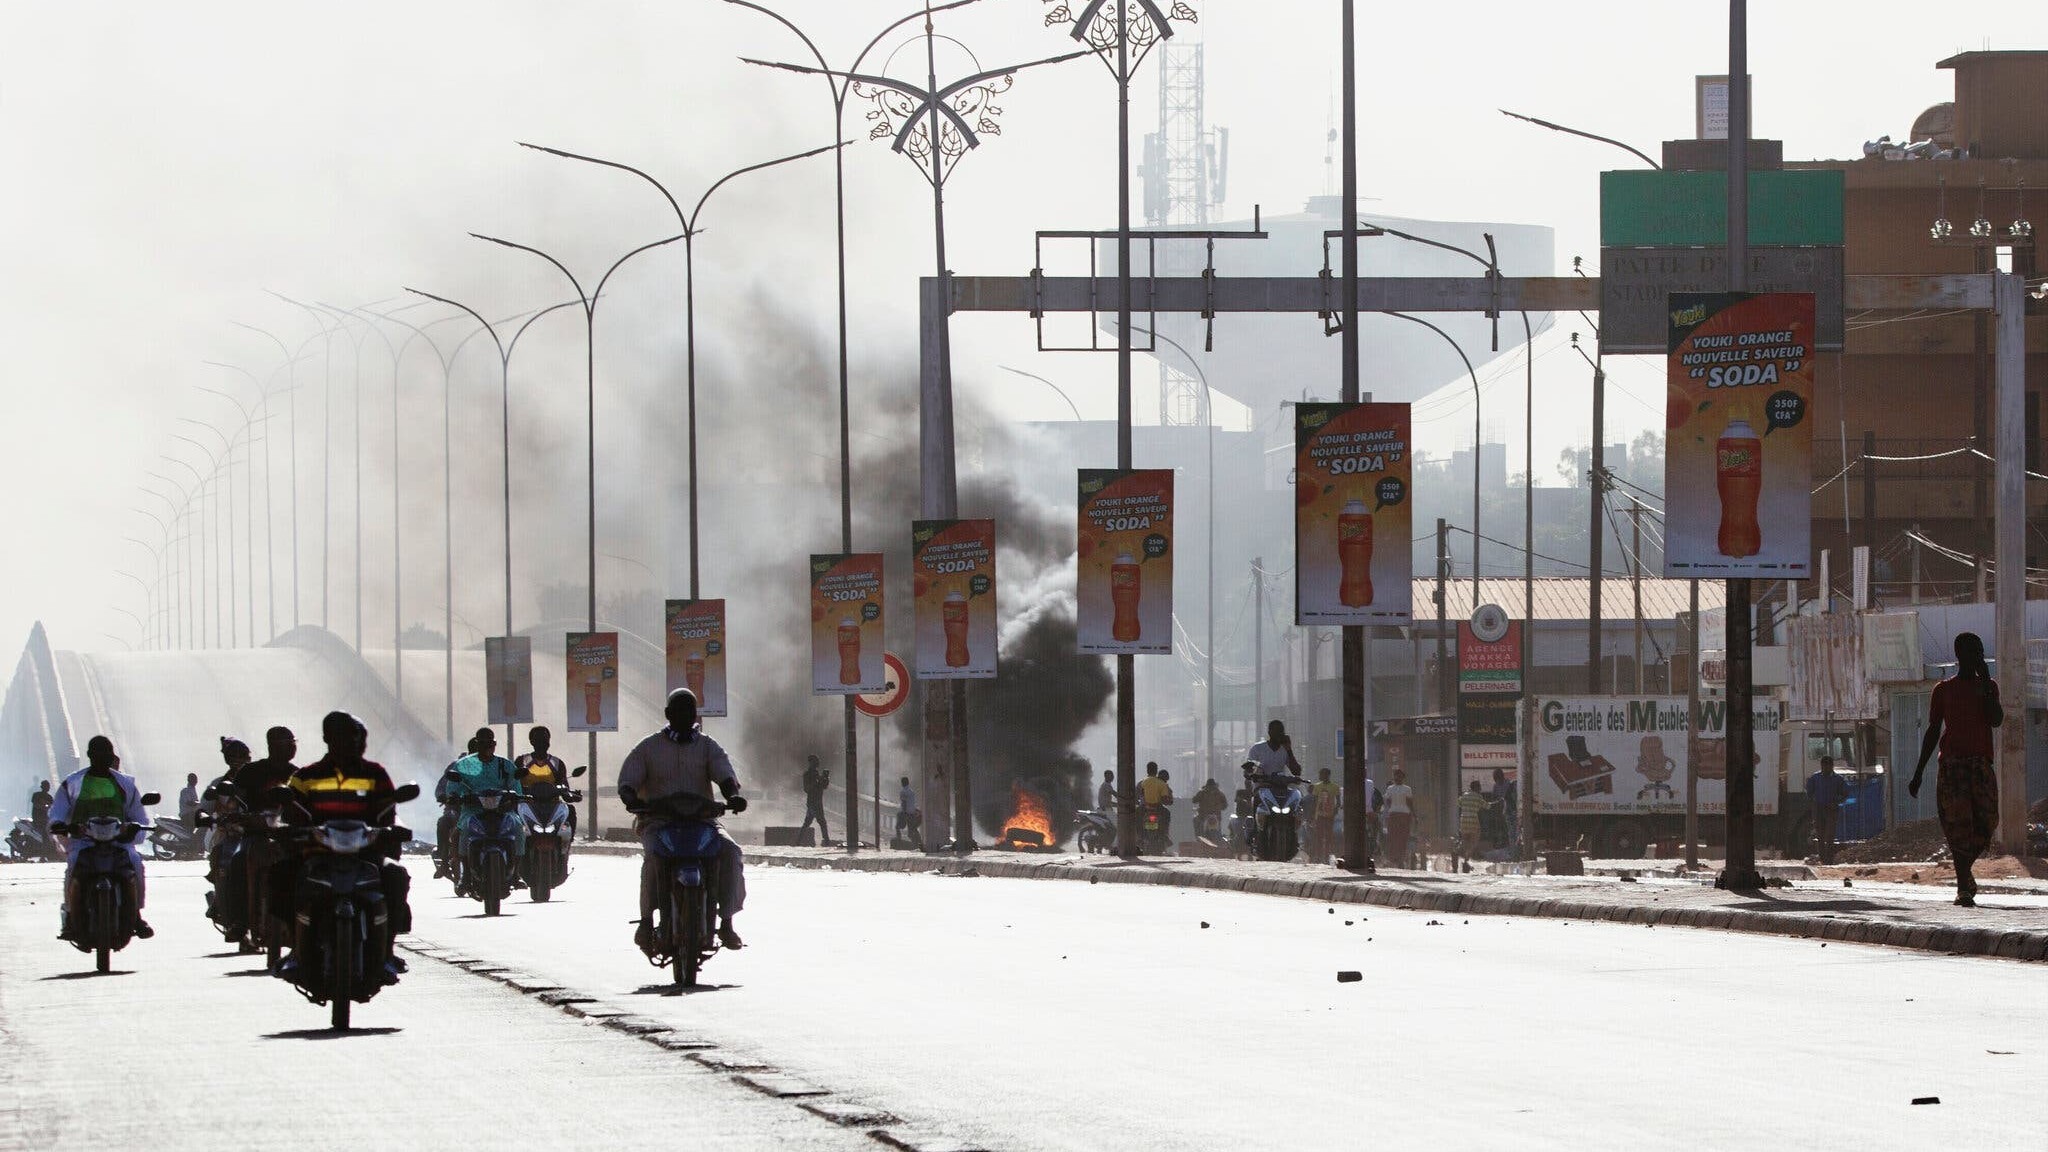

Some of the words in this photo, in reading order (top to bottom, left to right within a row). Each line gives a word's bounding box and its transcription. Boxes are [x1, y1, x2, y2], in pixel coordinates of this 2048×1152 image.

[1693, 335, 1733, 348] YOUKI
[1738, 331, 1792, 345] ORANGE
[1683, 350, 1749, 365] NOUVELLE
[1754, 346, 1804, 359] SAVEUR
[1775, 399, 1798, 408] 350F
[1319, 435, 1349, 445] YOUKI
[1353, 431, 1395, 442] ORANGE
[1311, 445, 1362, 457] NOUVELLE
[1366, 442, 1404, 453] SAVEUR
[1124, 495, 1160, 505] ORANGE
[1088, 508, 1132, 517] NOUVELLE
[1135, 505, 1168, 514] SAVEUR
[1467, 645, 1513, 653] AGENCE
[1468, 653, 1511, 661] MAKKA
[1463, 661, 1518, 669] VOYAGES
[1465, 682, 1516, 690] PELERINAGE
[1542, 700, 1602, 732] Générale
[1608, 705, 1625, 731] des
[1627, 700, 1689, 732] Meubles
[1415, 717, 1457, 726] Oran
